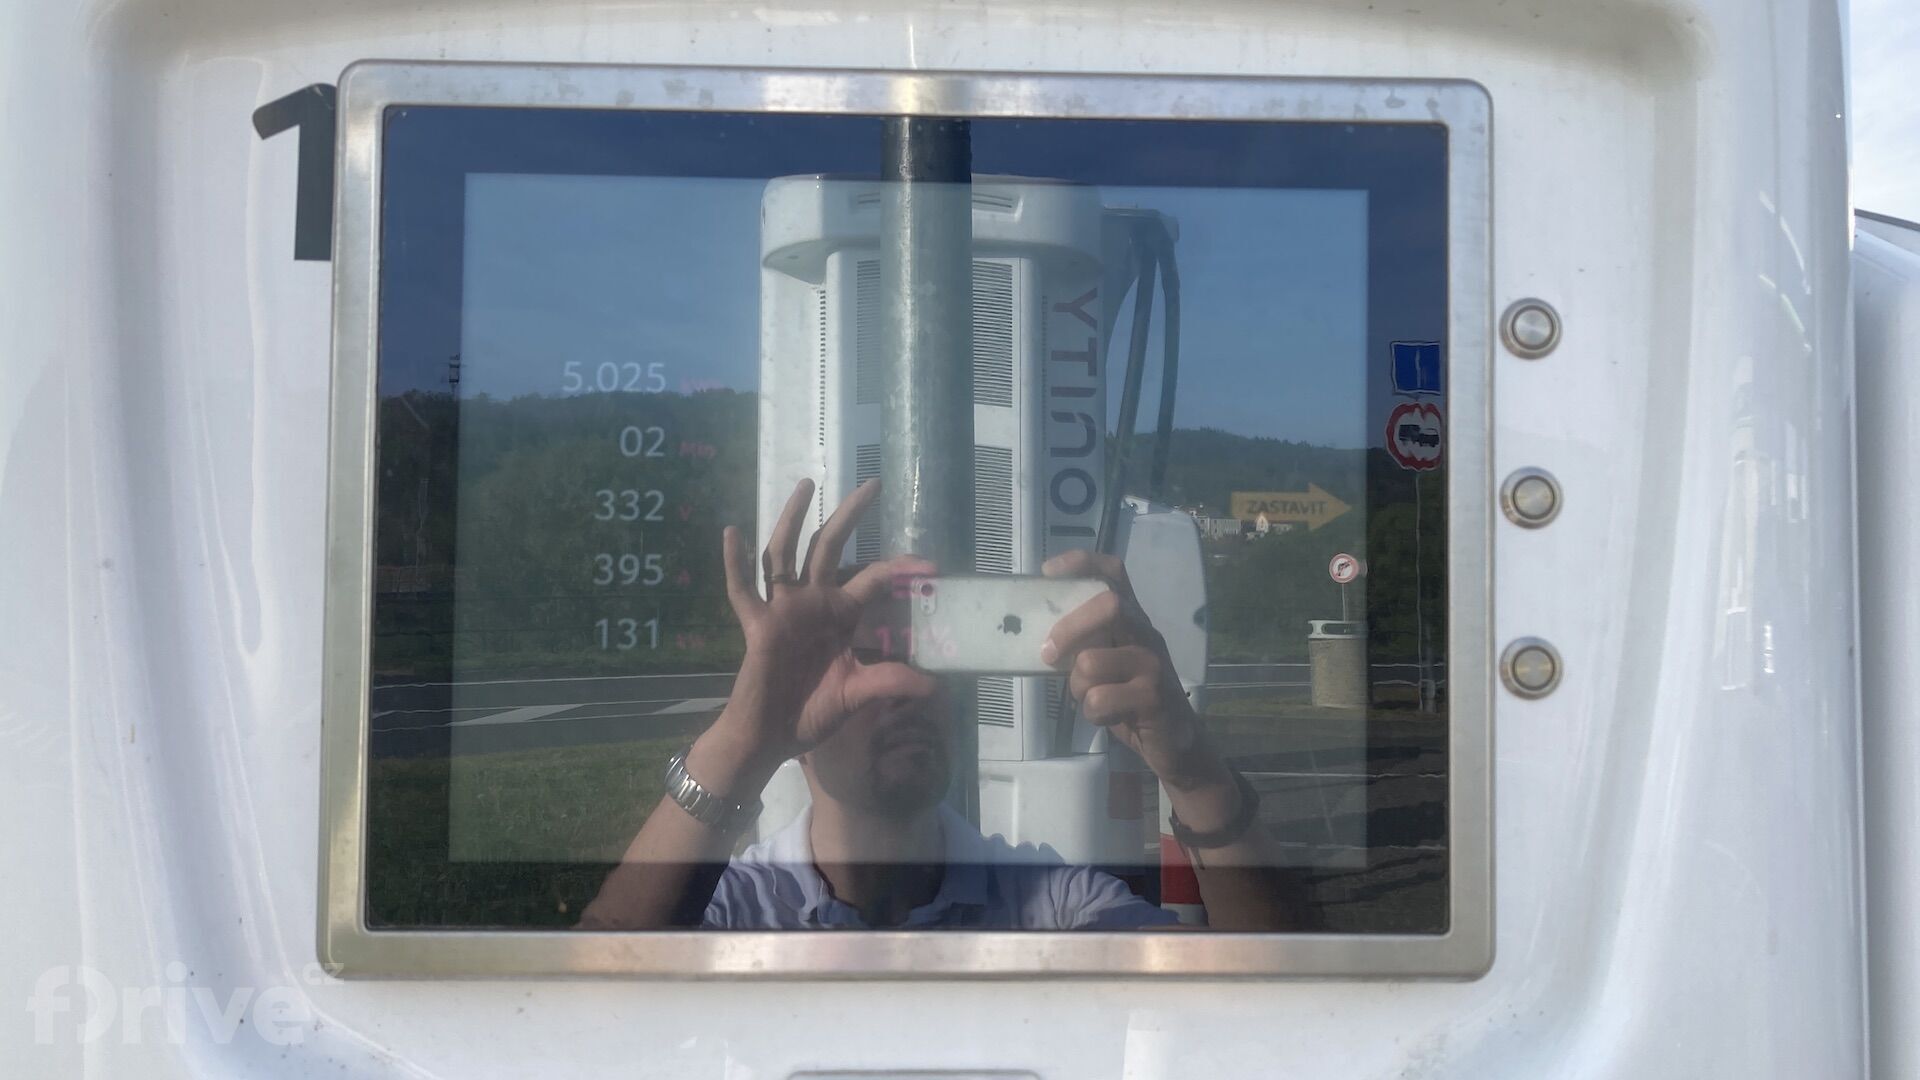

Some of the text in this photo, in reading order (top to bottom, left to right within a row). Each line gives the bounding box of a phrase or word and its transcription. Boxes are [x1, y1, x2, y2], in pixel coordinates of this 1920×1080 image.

[252, 83, 337, 261] 1
[562, 361, 667, 393] 5.025
[619, 426, 666, 457] 02
[594, 489, 665, 521] 332
[1246, 500, 1327, 515] ZASTAVIT
[593, 553, 665, 586] 395
[594, 618, 661, 650] 131
